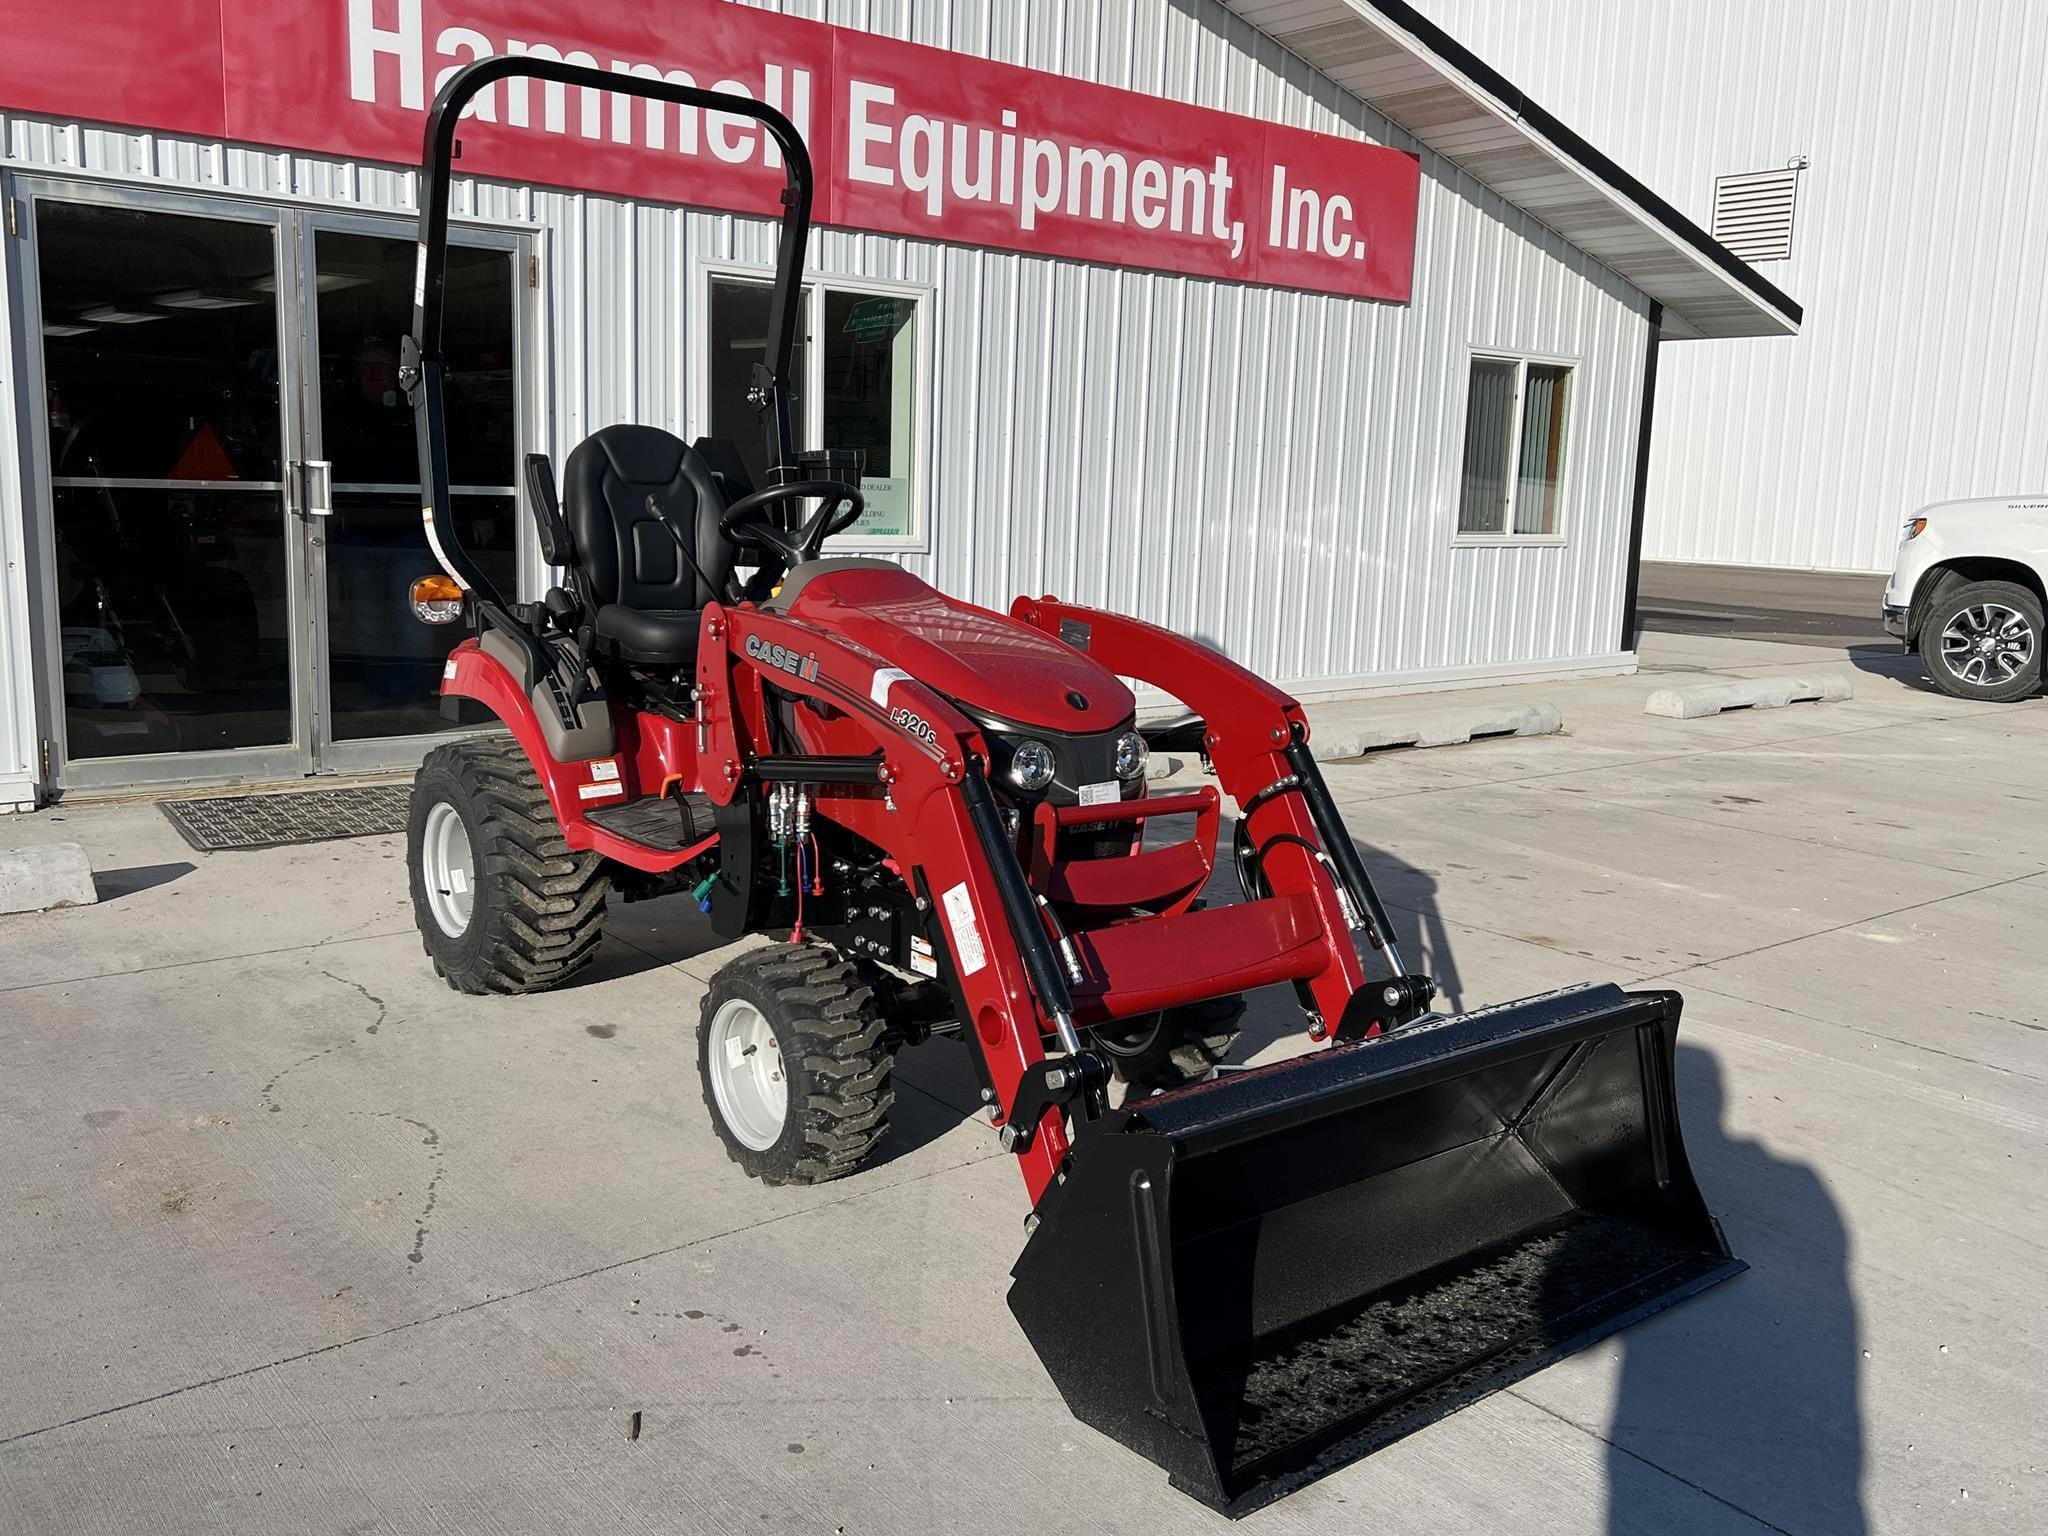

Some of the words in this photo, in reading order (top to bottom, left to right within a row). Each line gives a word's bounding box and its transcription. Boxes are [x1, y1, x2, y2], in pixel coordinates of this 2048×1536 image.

[348, 0, 811, 169] Hammell
[848, 79, 1245, 260] Equipment,
[1268, 163, 1366, 260] Inc.
[867, 483, 892, 491] DEALER
[744, 633, 801, 677] CASE
